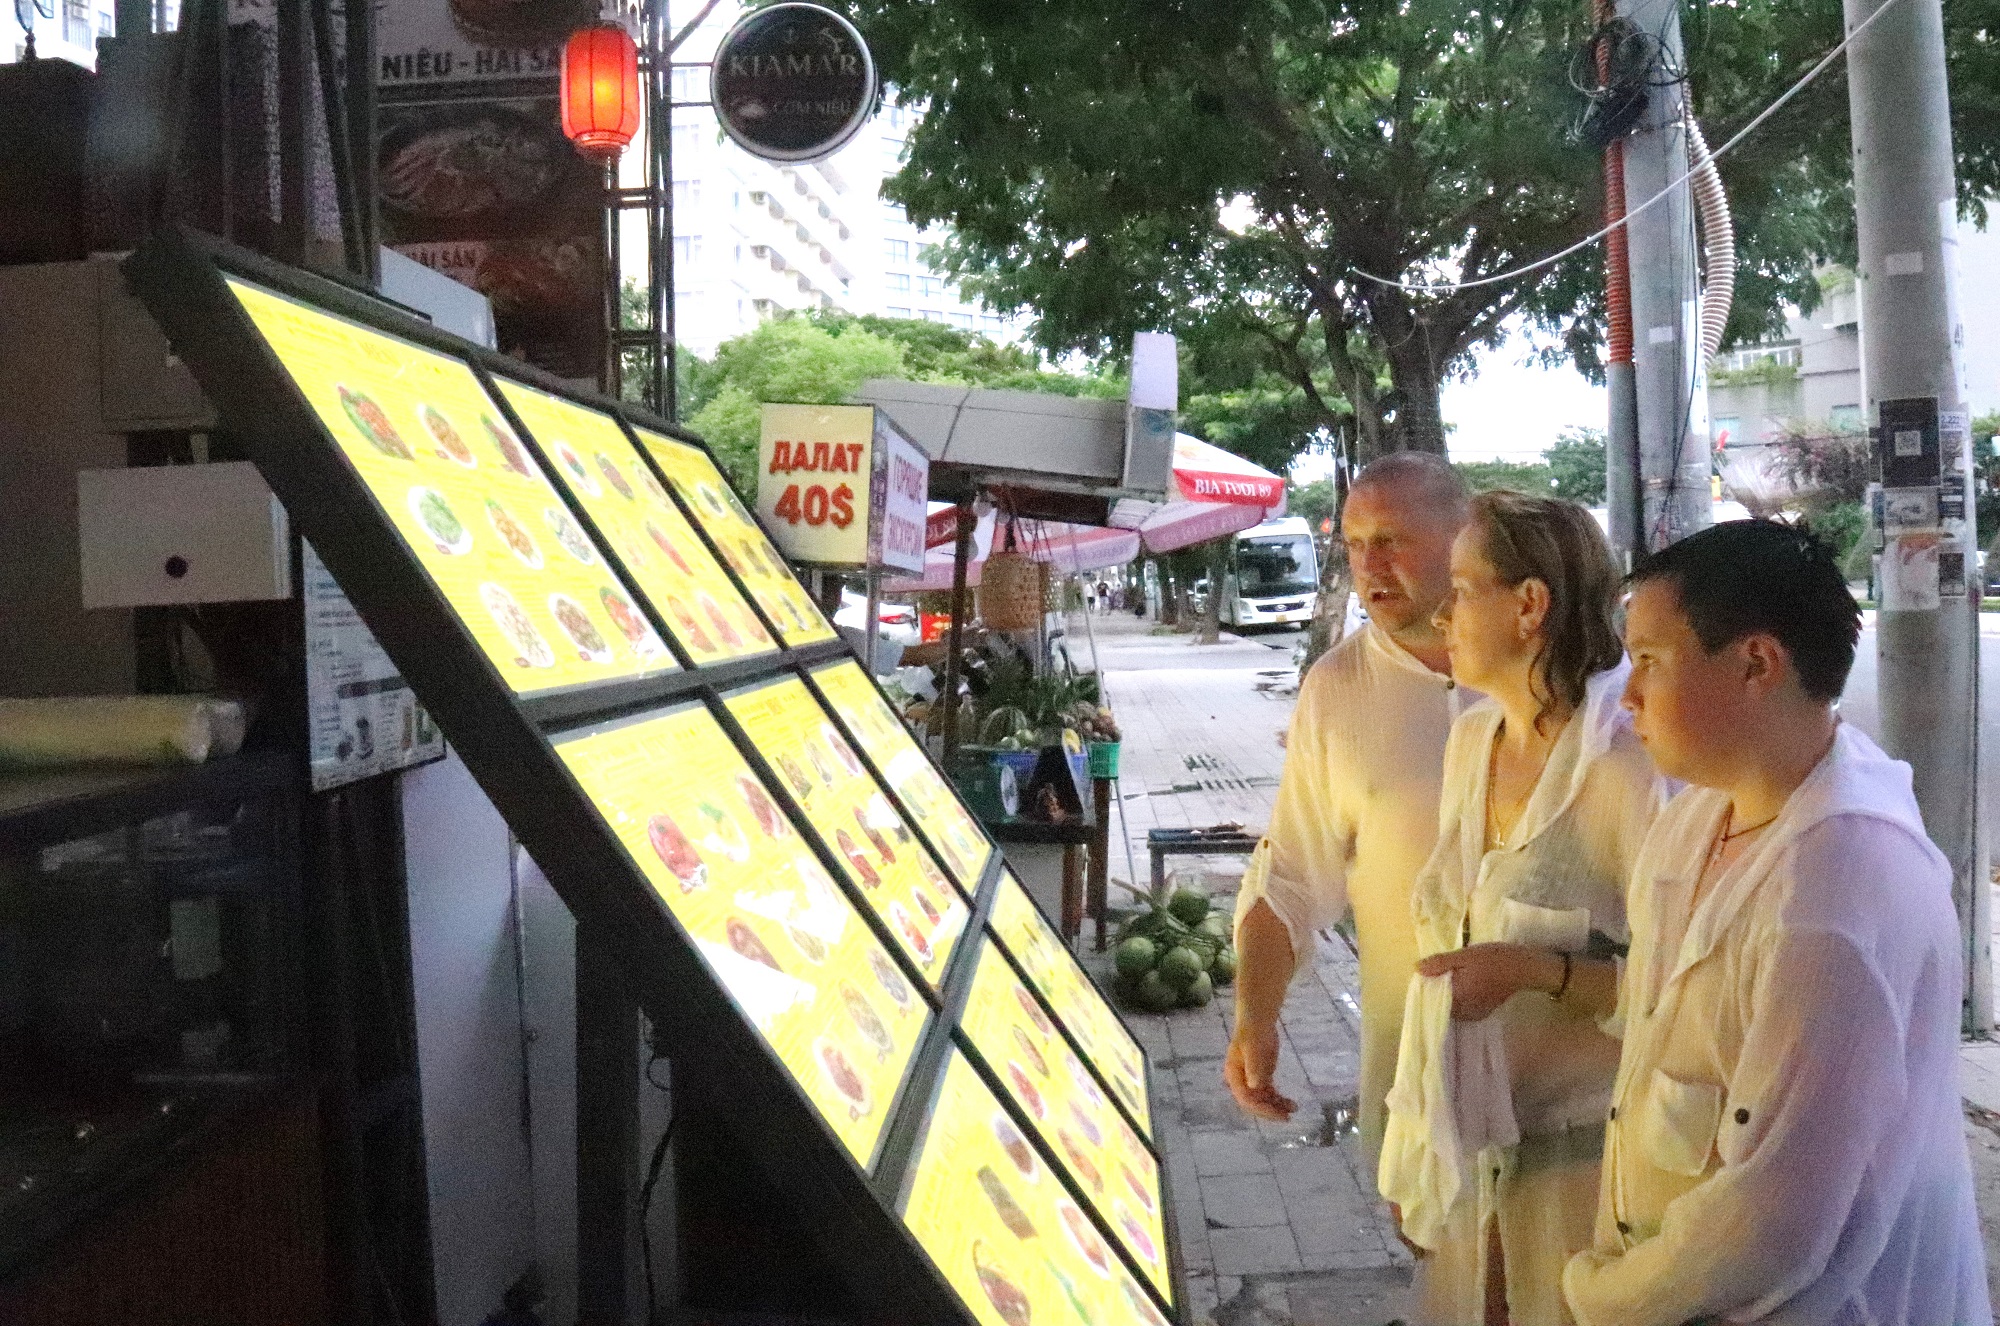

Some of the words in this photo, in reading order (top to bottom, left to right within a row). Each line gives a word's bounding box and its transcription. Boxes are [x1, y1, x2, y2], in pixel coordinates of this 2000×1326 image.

[730, 53, 858, 78] KIAMAR
[768, 440, 865, 475] ДАЛАТ
[1195, 479, 1221, 495] BIA
[1258, 484, 1272, 498] 89
[774, 482, 855, 530] 40$
